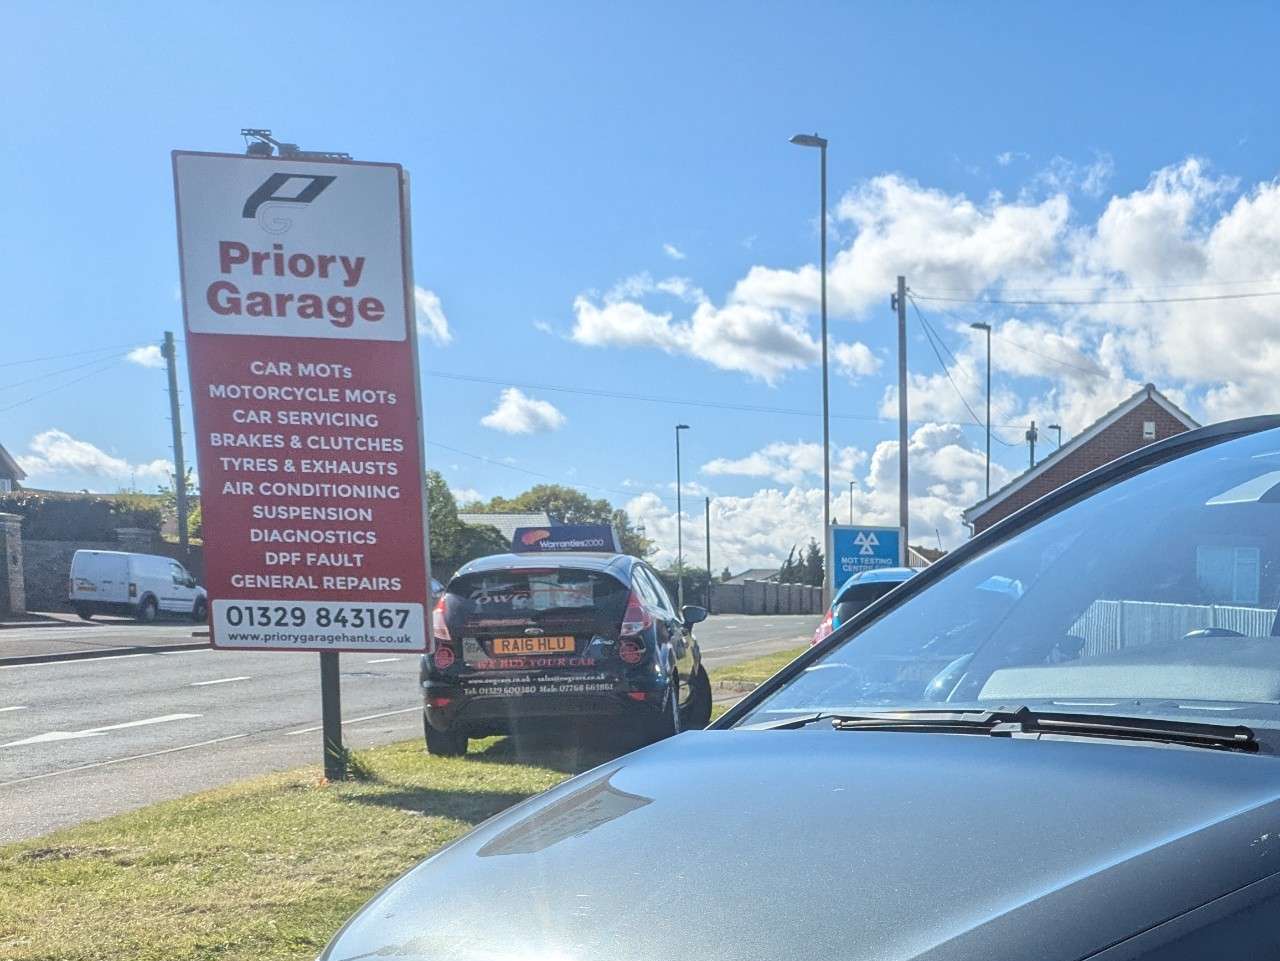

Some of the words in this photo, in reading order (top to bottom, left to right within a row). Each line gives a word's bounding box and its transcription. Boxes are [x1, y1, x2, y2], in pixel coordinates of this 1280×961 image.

[218, 240, 366, 288] Priory
[206, 280, 385, 328] Garage
[251, 361, 292, 376] CAR
[298, 362, 353, 379] MOTs
[209, 384, 340, 403] MOTORCYCLE
[345, 388, 397, 405] MOTs
[232, 409, 272, 424] CAR
[277, 411, 379, 428] SERVICING
[210, 433, 285, 449] BRAKES
[290, 436, 302, 449] &
[307, 435, 404, 452] CLUTCHES
[220, 457, 278, 472] TYRES
[284, 459, 296, 473] &
[301, 459, 398, 476] EXHAUSTS
[222, 481, 254, 496] AIR
[259, 482, 401, 499] CONDITIONING
[252, 505, 373, 522] SUSPENSION
[250, 528, 377, 545] DIAGNOSTICS
[265, 552, 301, 566] DPF
[306, 553, 364, 567] FAULT
[861, 557, 893, 565] TESTING
[231, 574, 318, 590] GENERAL
[322, 575, 402, 591] REPAIRS
[226, 605, 306, 628] 01329
[315, 608, 411, 630] 843167
[228, 631, 411, 644] www.priorygaragehants.co.uk
[501, 638, 533, 652] RA16
[537, 637, 567, 650] HLU
[569, 657, 596, 666] CAR
